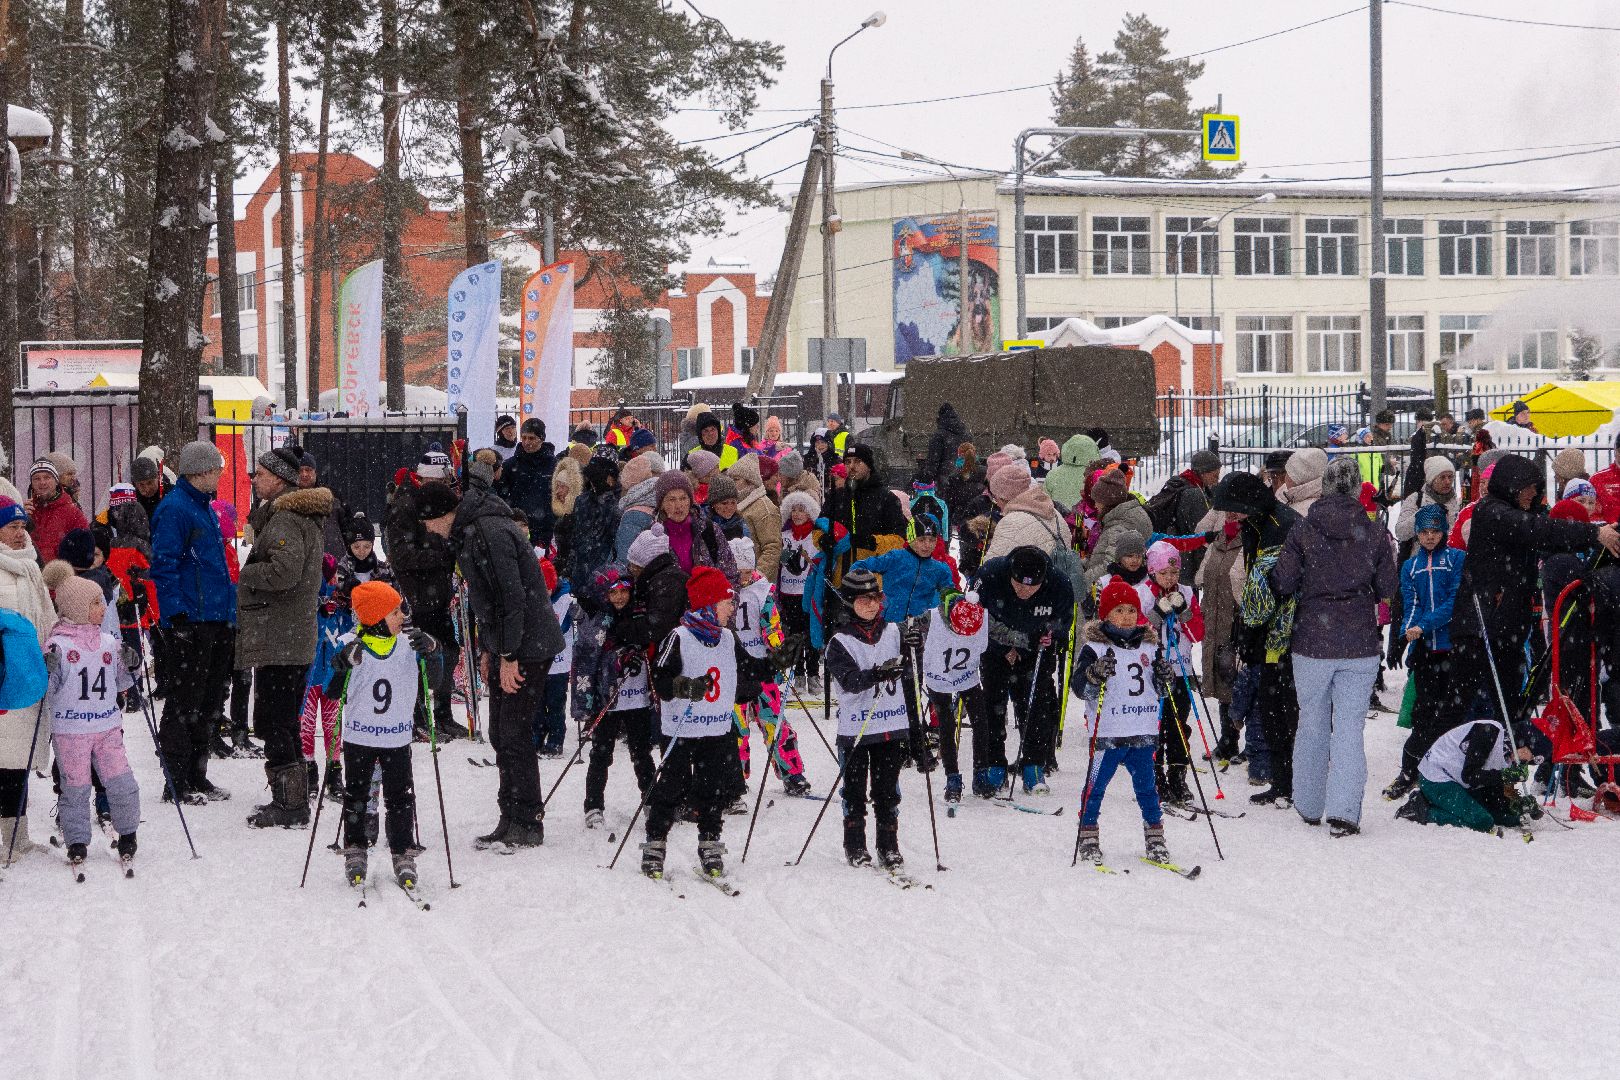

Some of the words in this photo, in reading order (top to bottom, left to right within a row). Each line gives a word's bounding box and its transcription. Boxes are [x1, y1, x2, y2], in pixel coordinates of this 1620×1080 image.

[943, 648, 970, 673] 12
[78, 667, 107, 700] 14
[372, 678, 392, 714] 9
[1128, 663, 1144, 696] 3
